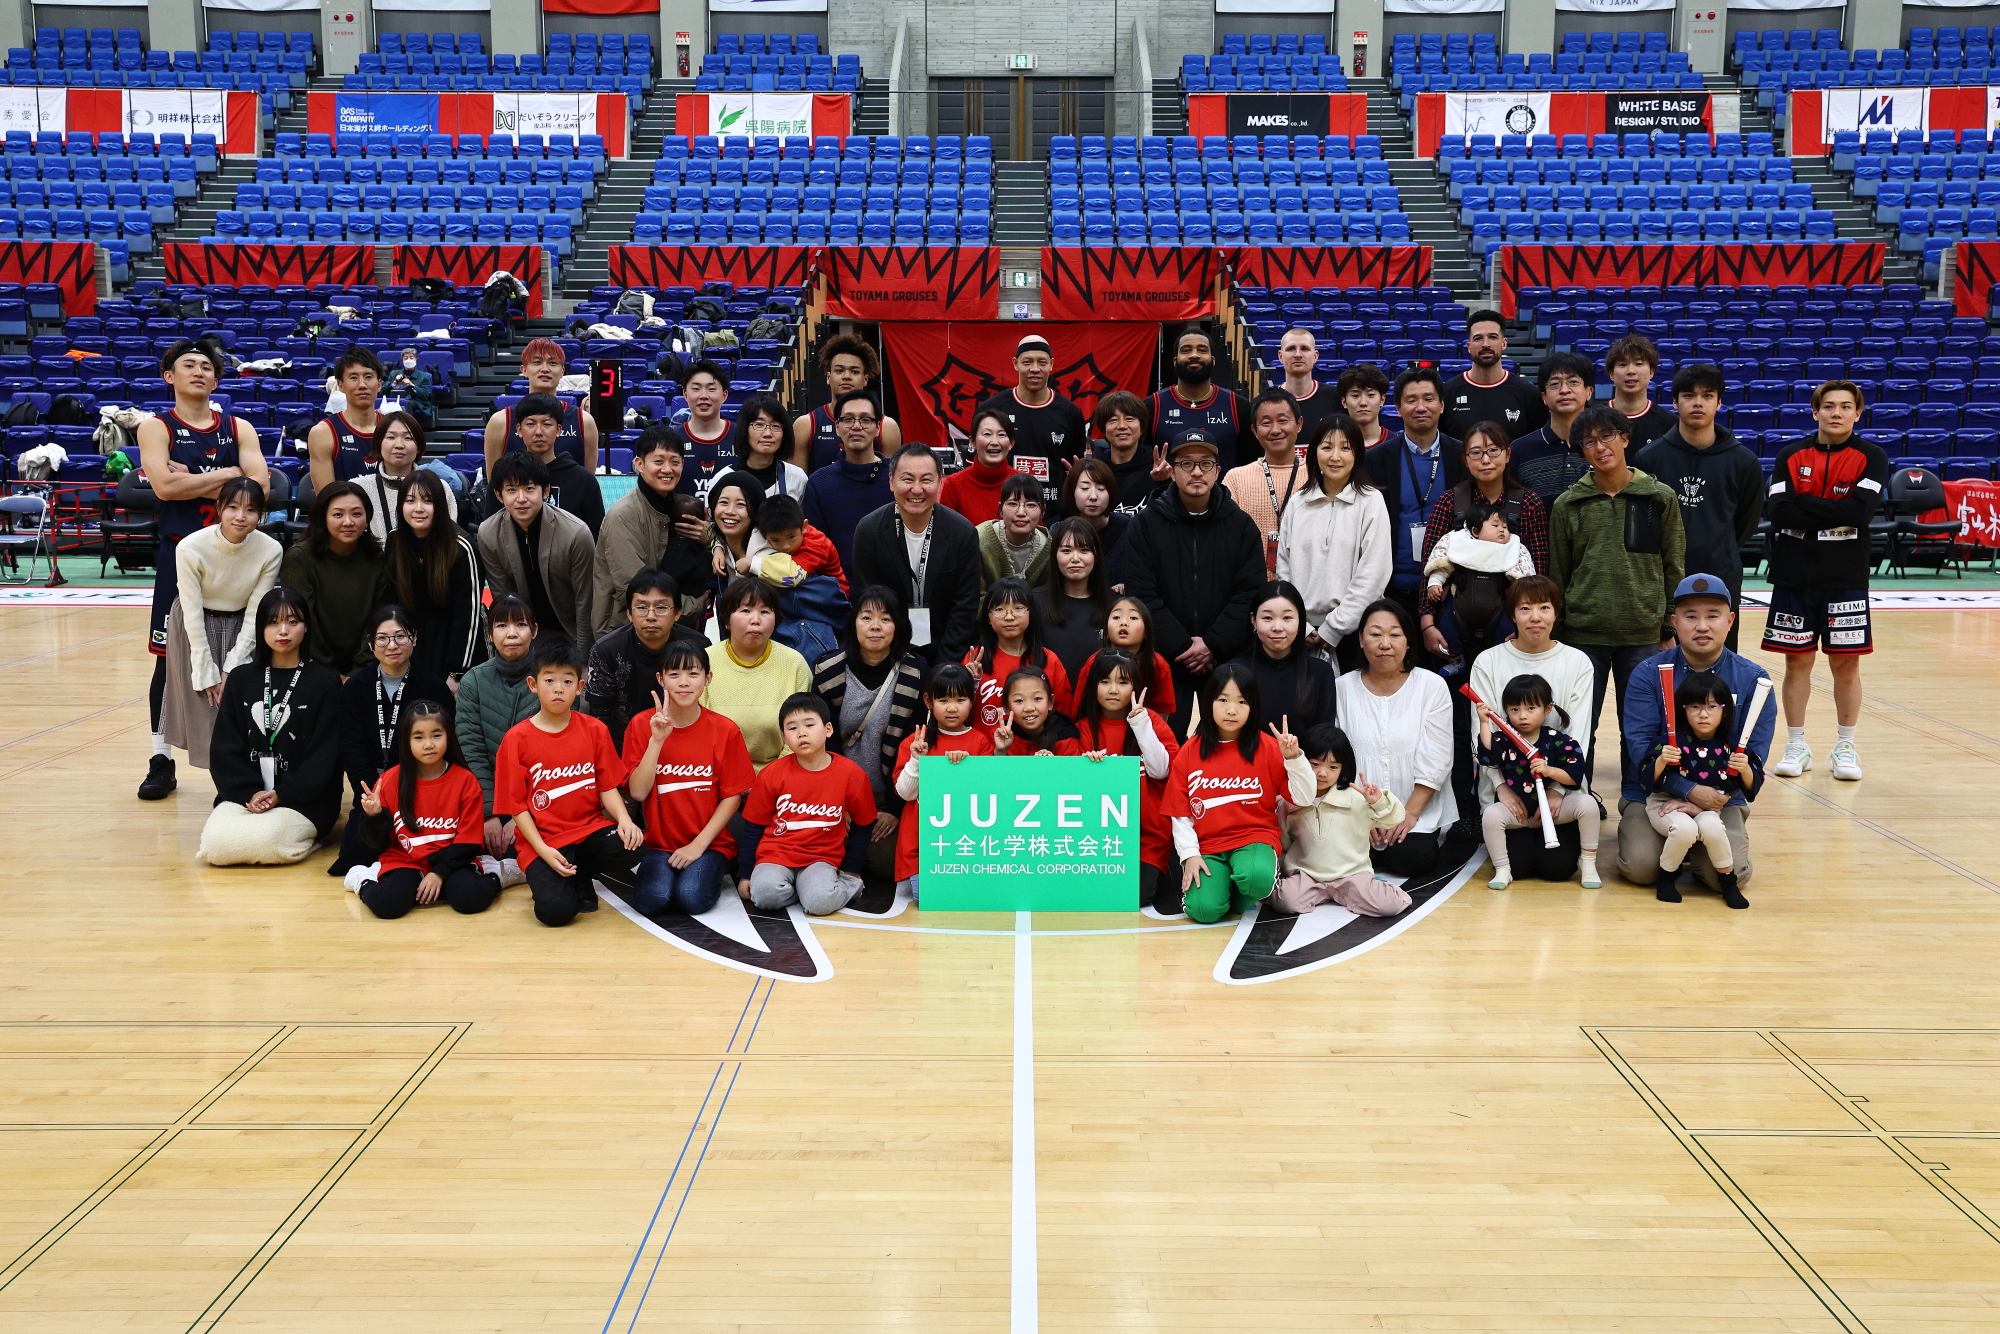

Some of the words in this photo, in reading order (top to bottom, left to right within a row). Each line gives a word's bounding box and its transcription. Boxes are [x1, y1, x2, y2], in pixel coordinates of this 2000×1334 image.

[340, 107, 355, 115] GAS
[1618, 100, 1660, 111] WHITE
[1662, 100, 1696, 111] BASE
[158, 112, 223, 124] 明祥株式会社
[340, 115, 375, 123] COMPANY
[518, 112, 595, 122] だいぞうクリニック
[1246, 115, 1289, 126] MAKES
[339, 124, 433, 132] 日本海ガス絆ホールディングス
[850, 290, 889, 301] TOYAMA
[892, 291, 938, 302] GROUSES
[1102, 291, 1142, 302] TOYAMA
[1145, 291, 1190, 302] GROUSES
[600, 369, 615, 396] 3
[1836, 602, 1865, 612] KEIMA
[1776, 613, 1803, 625] SATO
[1187, 769, 1262, 797] Grouses
[776, 793, 843, 818] Grouses
[929, 794, 1129, 829] JUZEN
[930, 834, 1125, 857] 十全化学株式会社
[930, 863, 969, 875] JUZEN
[972, 863, 1035, 875] CHEMICAL
[1037, 863, 1126, 875] CORPORATION
